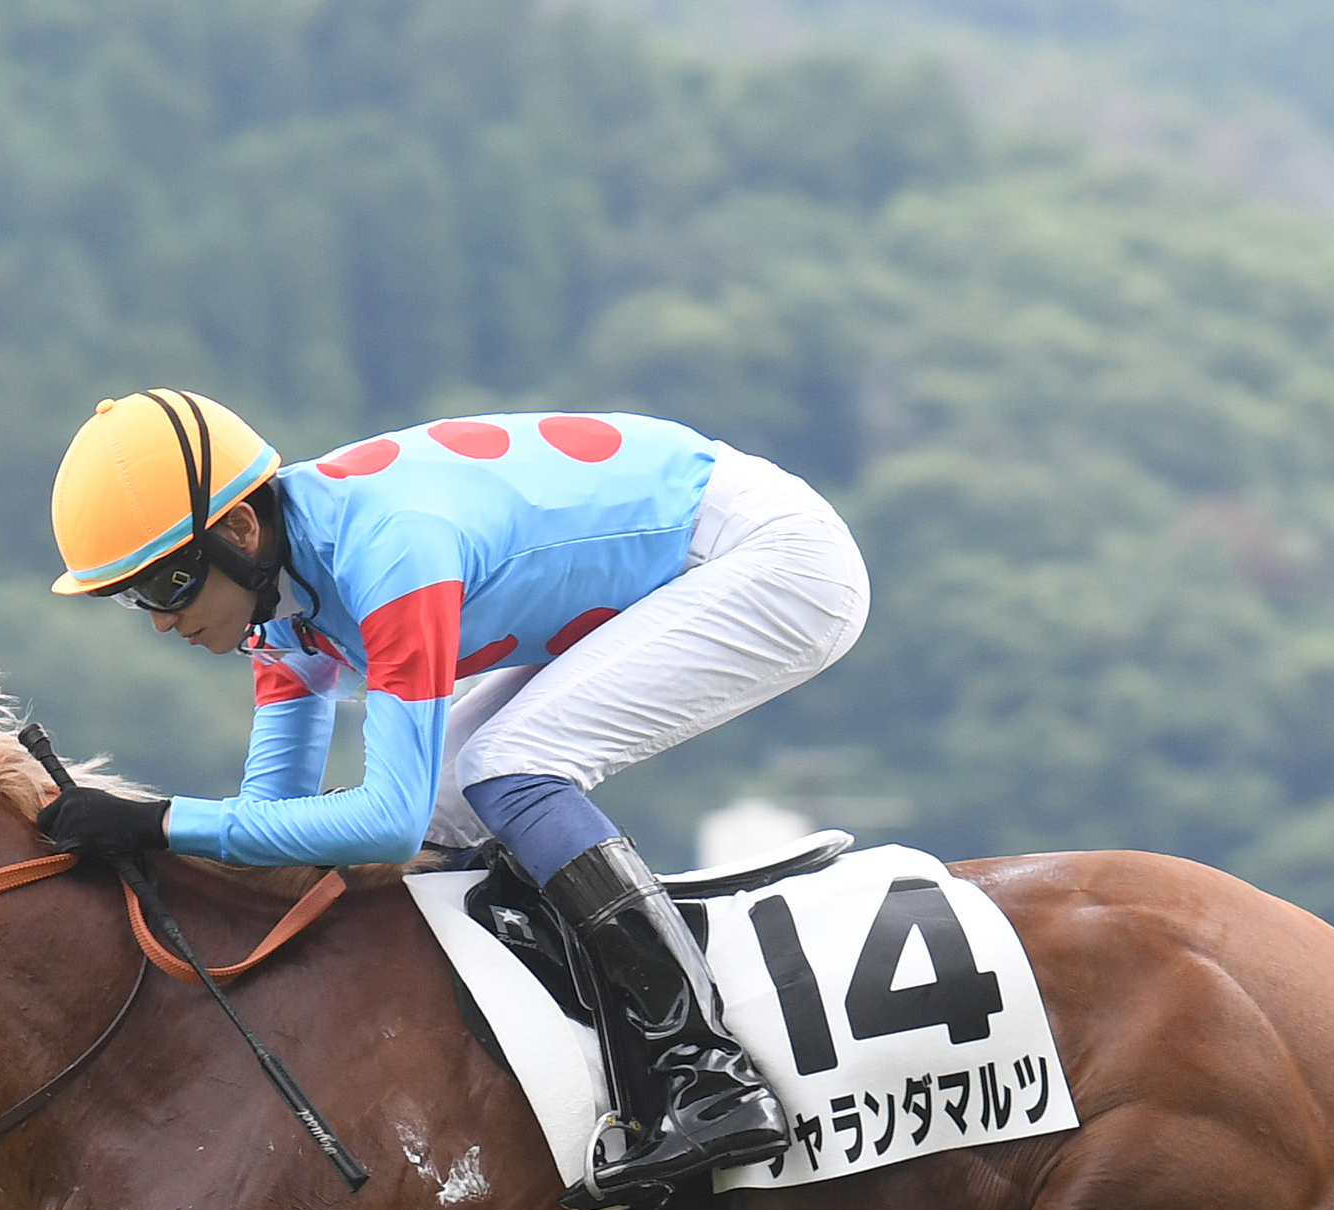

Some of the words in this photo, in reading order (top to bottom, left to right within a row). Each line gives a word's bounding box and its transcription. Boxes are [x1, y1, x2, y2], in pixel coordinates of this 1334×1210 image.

[748, 876, 1004, 1077] 14
[768, 1055, 1047, 1179] ャランダマルツ
